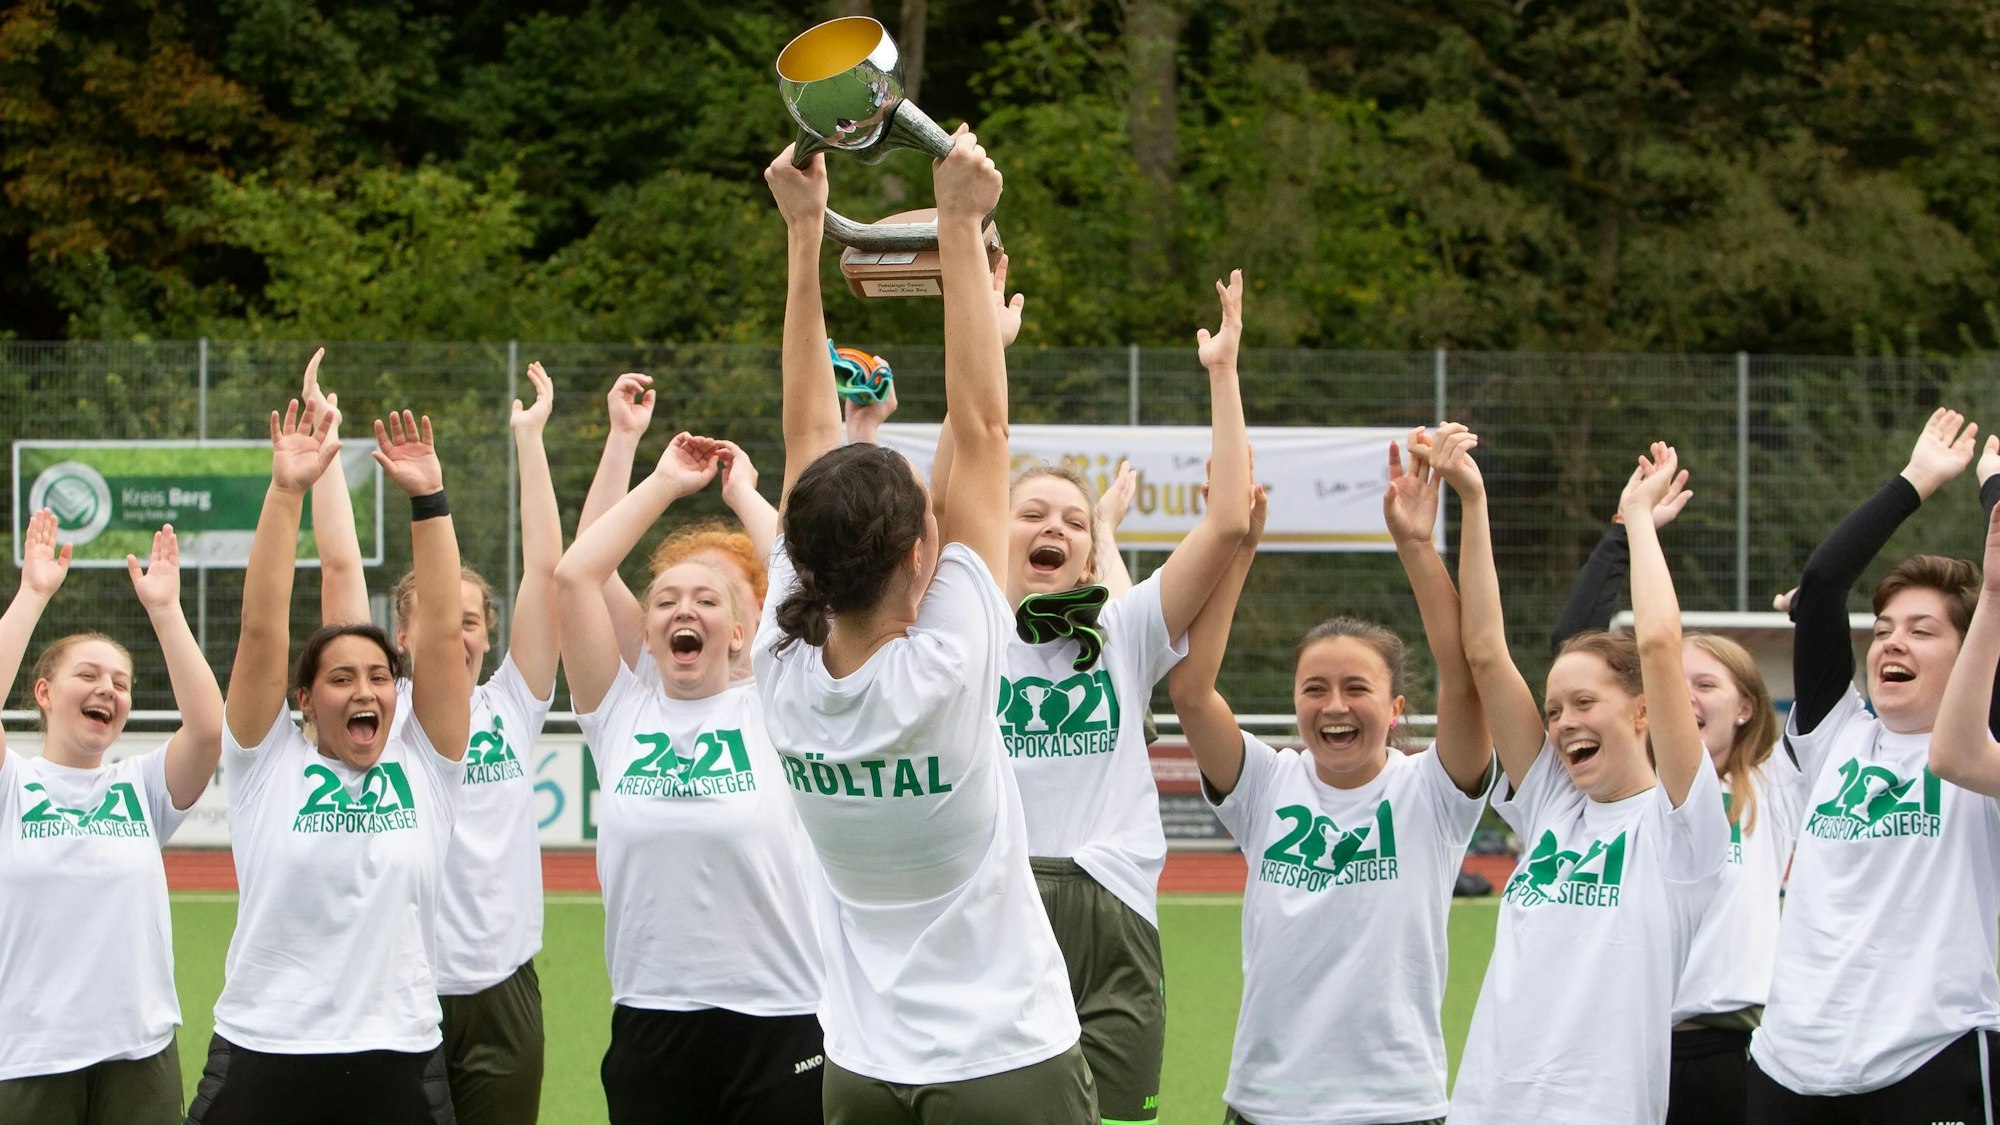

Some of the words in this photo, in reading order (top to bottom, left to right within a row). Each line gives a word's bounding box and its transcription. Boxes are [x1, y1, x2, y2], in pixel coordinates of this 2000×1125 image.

[122, 488, 166, 507] Kreis
[168, 487, 212, 511] Berg
[1003, 728, 1119, 758] SPOKALSIEGE
[22, 782, 145, 827] 221
[21, 821, 150, 839] KREISPALSIEGER
[293, 811, 418, 833] KREISPOKASIEGER
[1259, 859, 1398, 893] KREISPOKLSIEGER
[794, 1054, 823, 1074] JAKO
